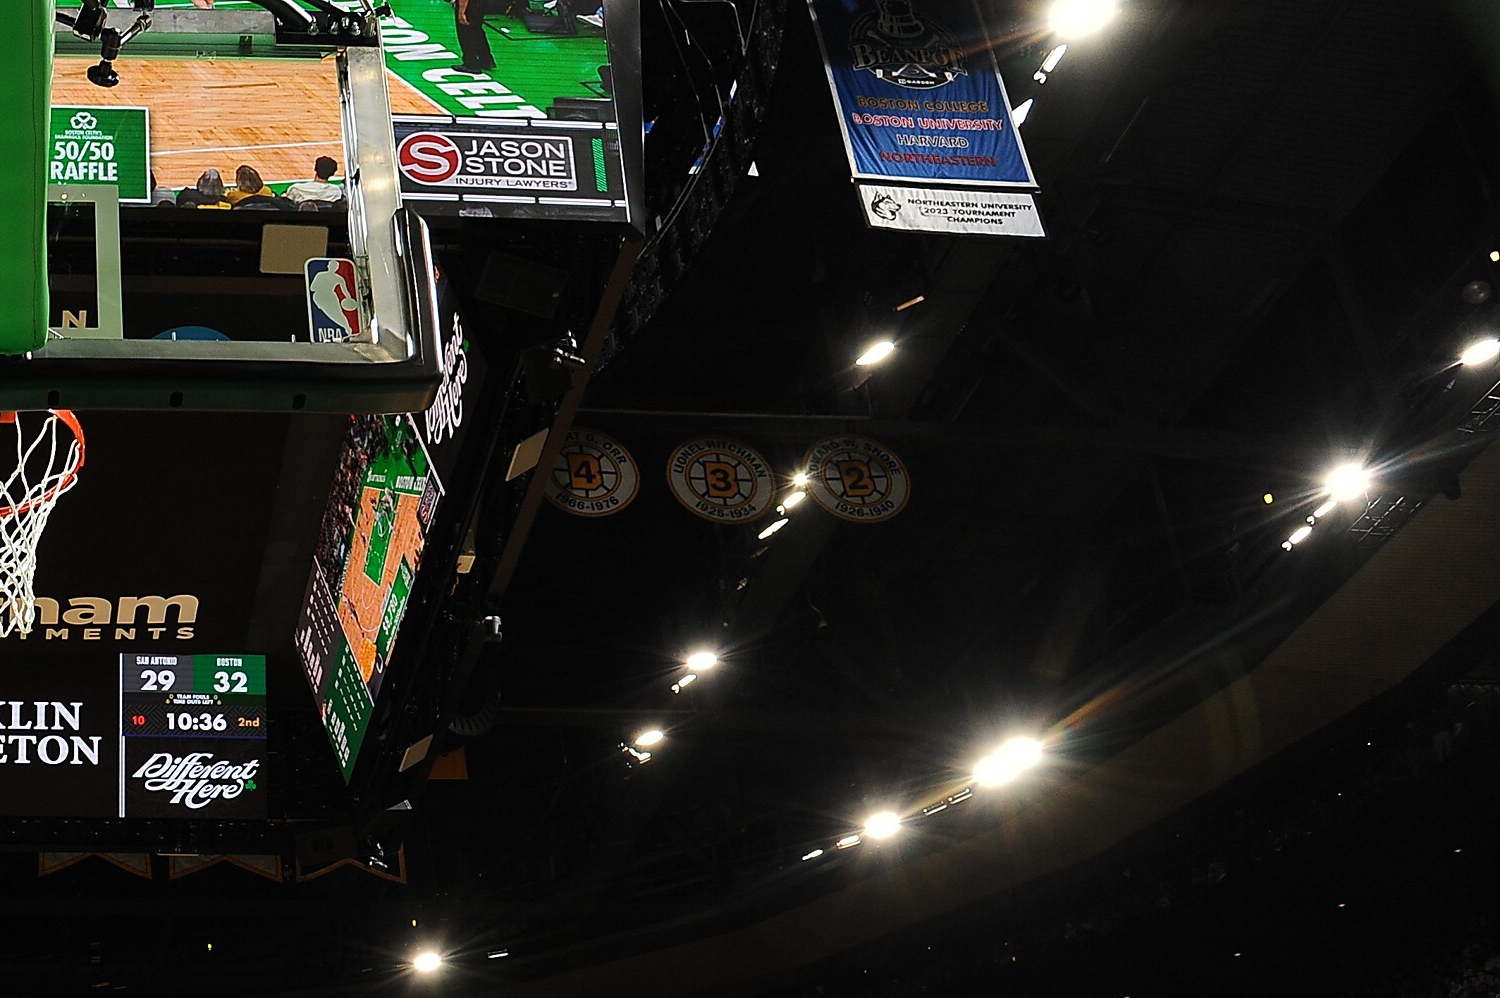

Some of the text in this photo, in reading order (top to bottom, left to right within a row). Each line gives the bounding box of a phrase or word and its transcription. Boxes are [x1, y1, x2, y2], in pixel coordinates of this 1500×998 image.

[856, 96, 989, 113] BOSTON COLLEGE
[852, 113, 1002, 130] BOSTON UNIVERSITY
[464, 140, 564, 159] JASON
[896, 134, 969, 148] HARVARD
[54, 141, 115, 162] 50/50
[879, 151, 997, 167] NORTHEASTERN
[50, 161, 118, 181] RAFFLE
[465, 158, 567, 177] STONE
[455, 177, 501, 187] INJURY
[907, 198, 1032, 211] NORTHEASTERN UNIVERSITY
[923, 207, 1016, 218] 2023 TOURNAMENT
[947, 215, 1003, 225] CHAMPIONS
[604, 442, 626, 465] ORR
[674, 440, 704, 474] LIONEL
[863, 442, 900, 475] SHORE
[574, 461, 595, 484] 4
[711, 469, 731, 492] 3
[844, 468, 869, 489] 2
[695, 501, 757, 518] 1925-1934
[834, 500, 895, 517] 1926-1940
[136, 656, 243, 667] SAN ANTONIO BOSTON
[141, 670, 248, 693] 29 32
[132, 713, 260, 731] 10 10:36 2nd
[132, 753, 260, 791] Different
[168, 779, 245, 809] Here
